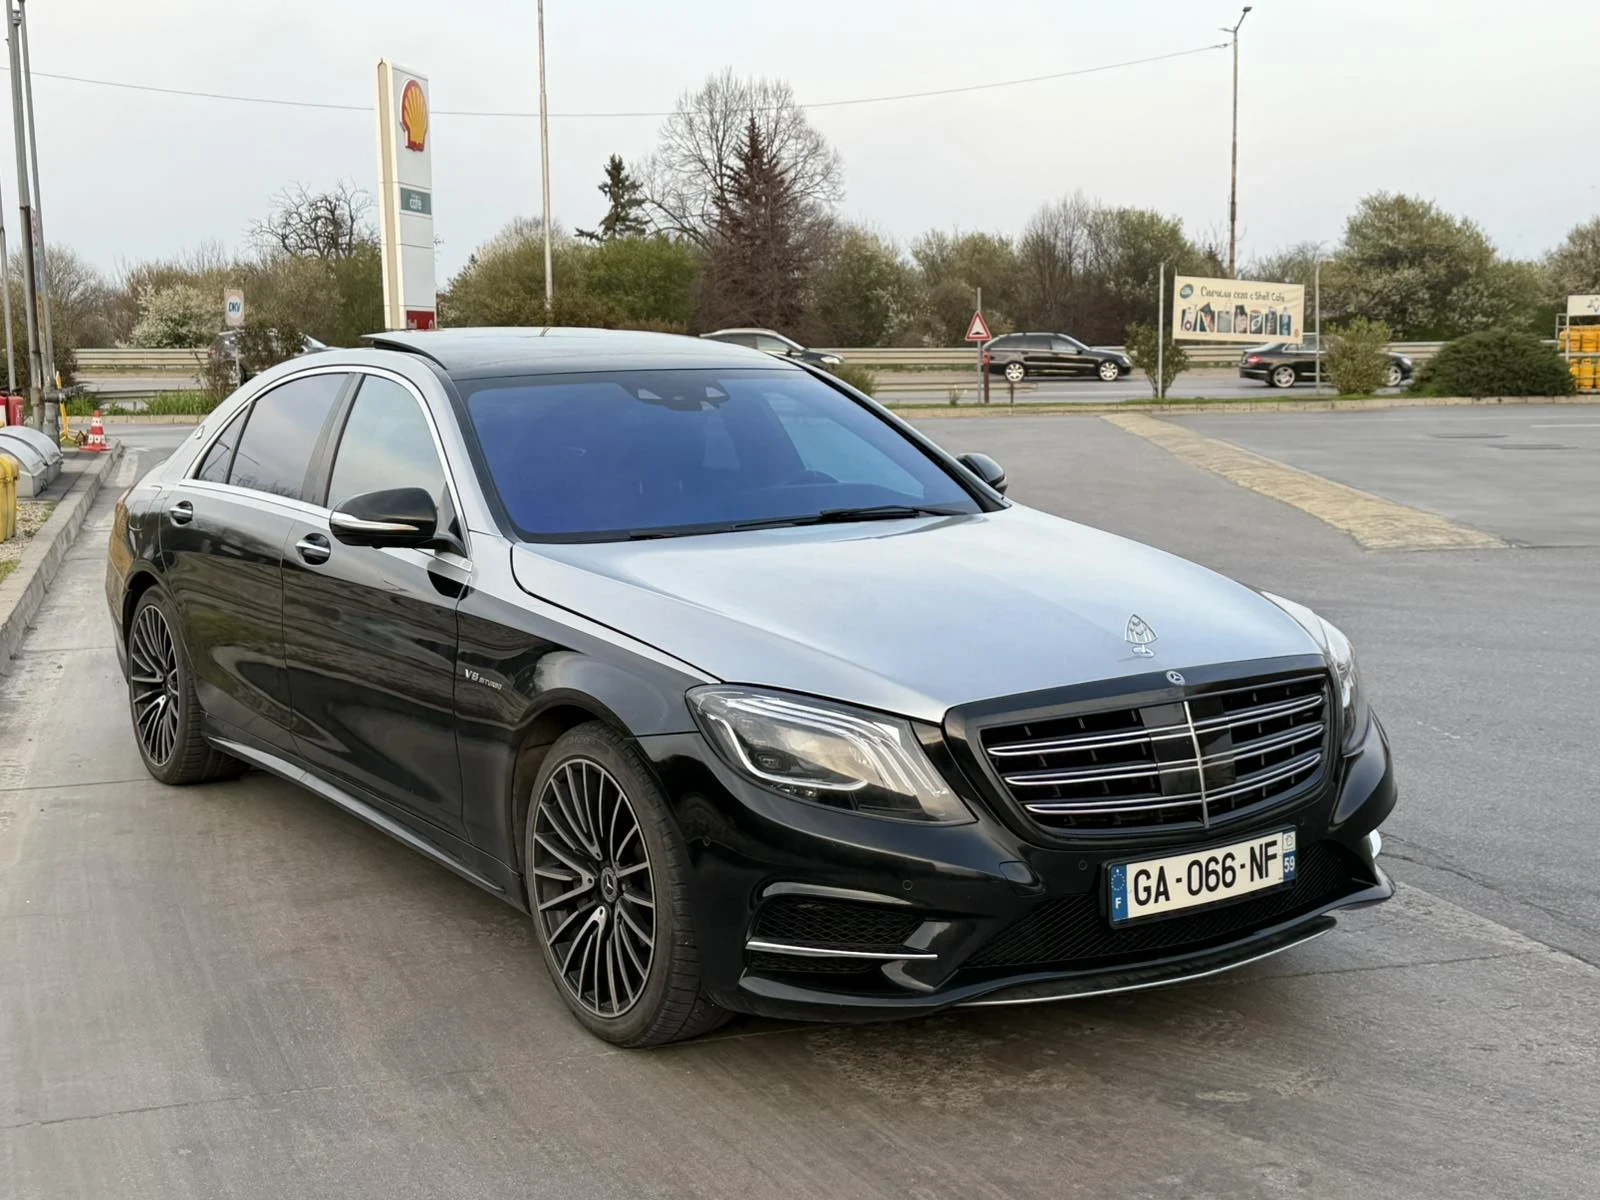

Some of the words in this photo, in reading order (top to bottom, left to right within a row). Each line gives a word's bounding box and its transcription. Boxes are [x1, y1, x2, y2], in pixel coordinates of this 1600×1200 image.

[1255, 291, 1270, 302] Shell
[228, 302, 241, 313] DKV
[465, 668, 479, 681] V8
[1283, 855, 1296, 873] 59
[1133, 839, 1278, 906] GA-066-NF
[1115, 897, 1122, 909] F
